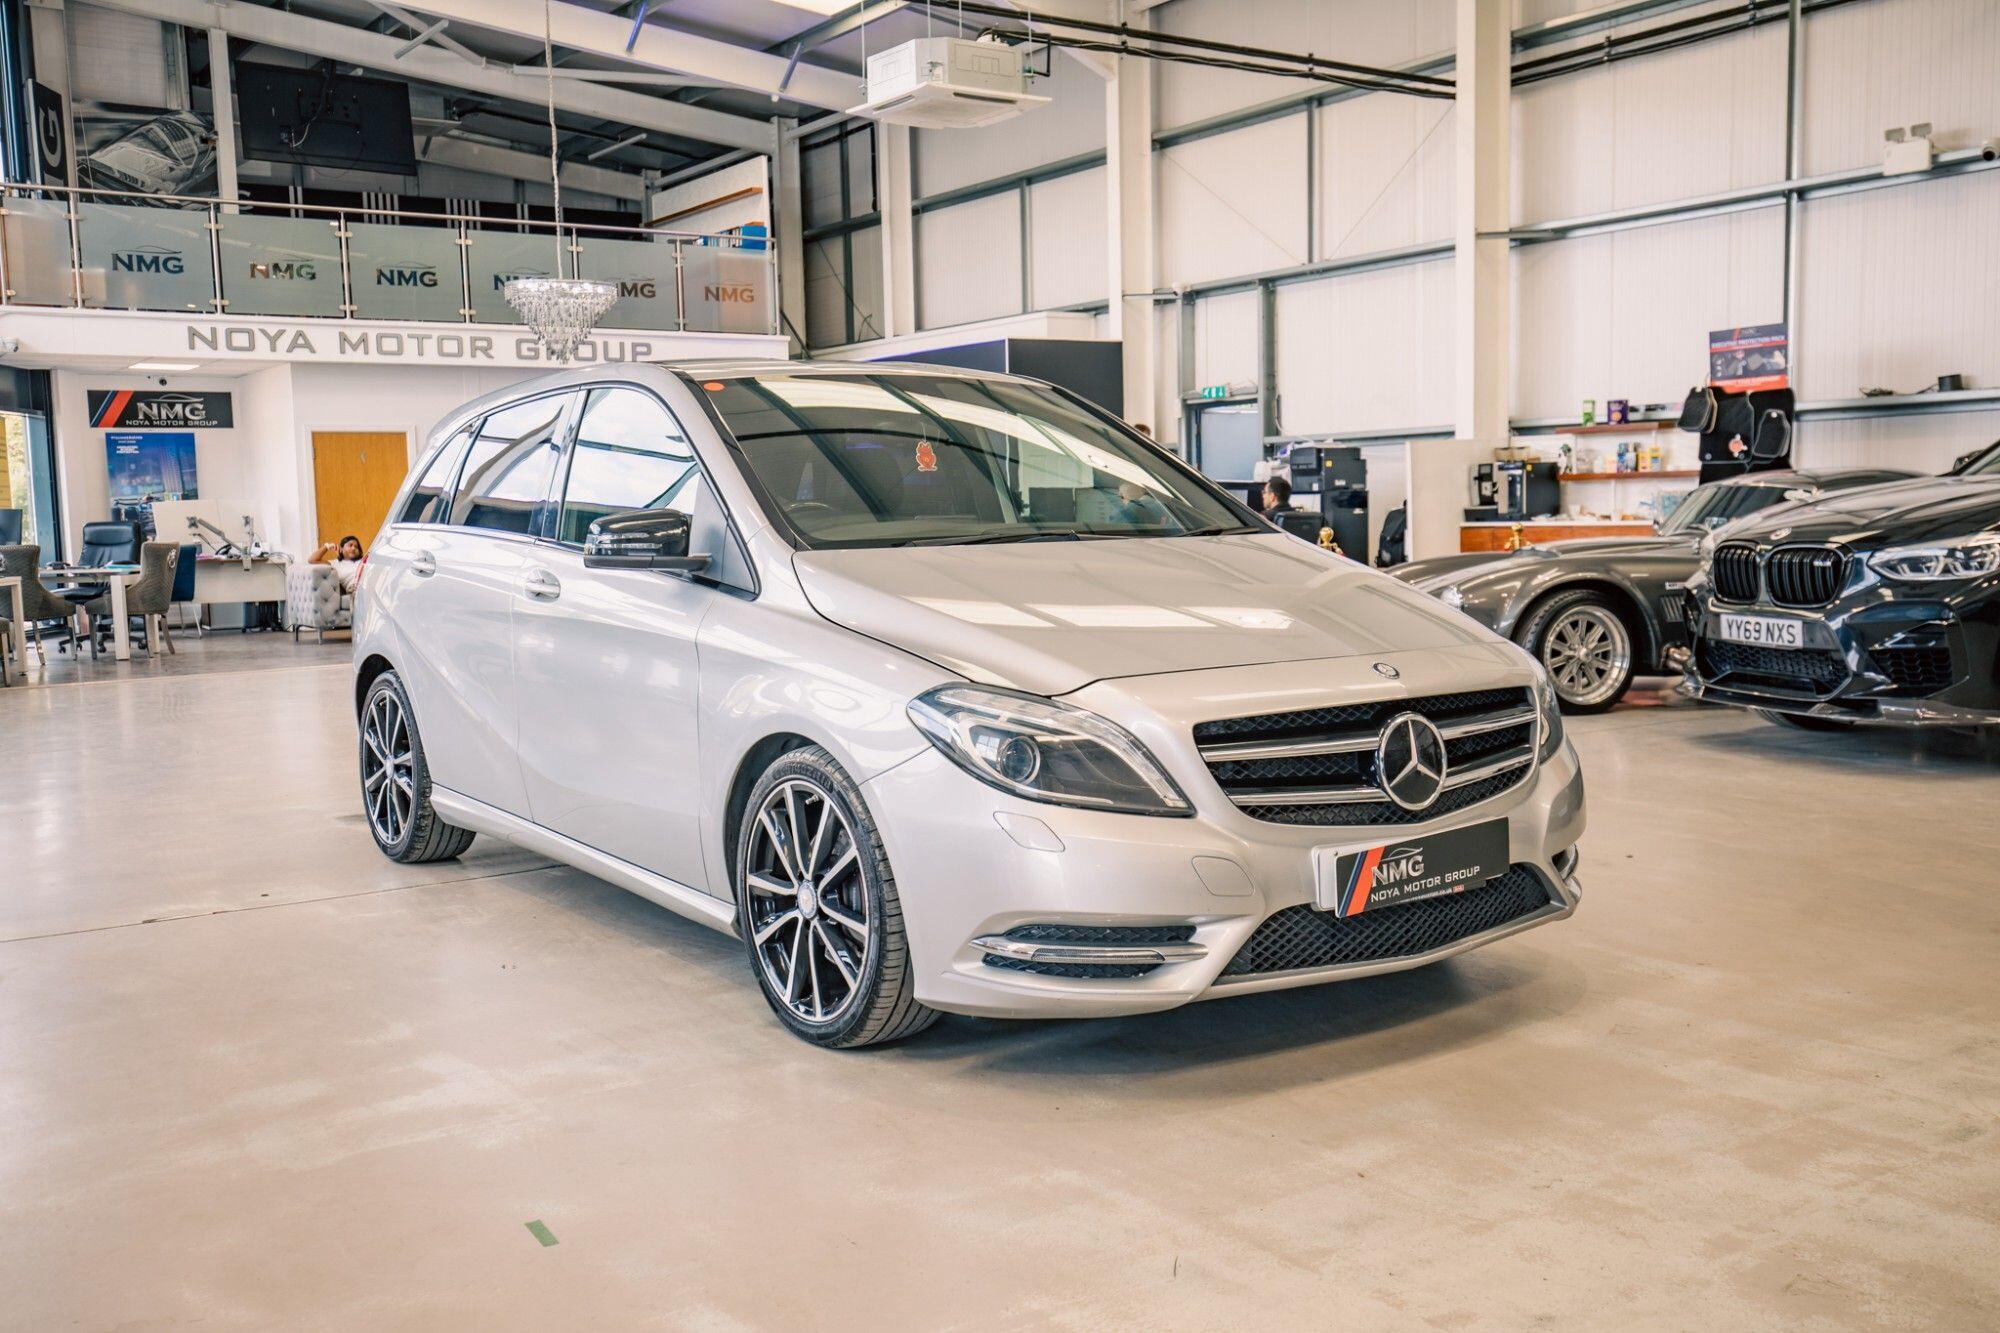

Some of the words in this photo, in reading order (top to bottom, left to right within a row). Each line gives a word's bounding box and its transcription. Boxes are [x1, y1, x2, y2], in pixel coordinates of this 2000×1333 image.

[112, 253, 184, 274] NMG
[250, 262, 317, 281] NMG
[376, 268, 438, 287] NMG
[615, 281, 656, 298] MG
[704, 285, 754, 304] NMG
[187, 325, 316, 354] NOYA
[338, 331, 494, 359] MOTOR
[136, 402, 206, 420] NMG
[1727, 618, 1762, 641] YY69
[1766, 621, 1796, 645] NXS
[1371, 855, 1425, 888] NMG
[1370, 887, 1400, 903] NOYA
[1404, 876, 1441, 894] MOTOR
[1444, 865, 1480, 883] GROUP
